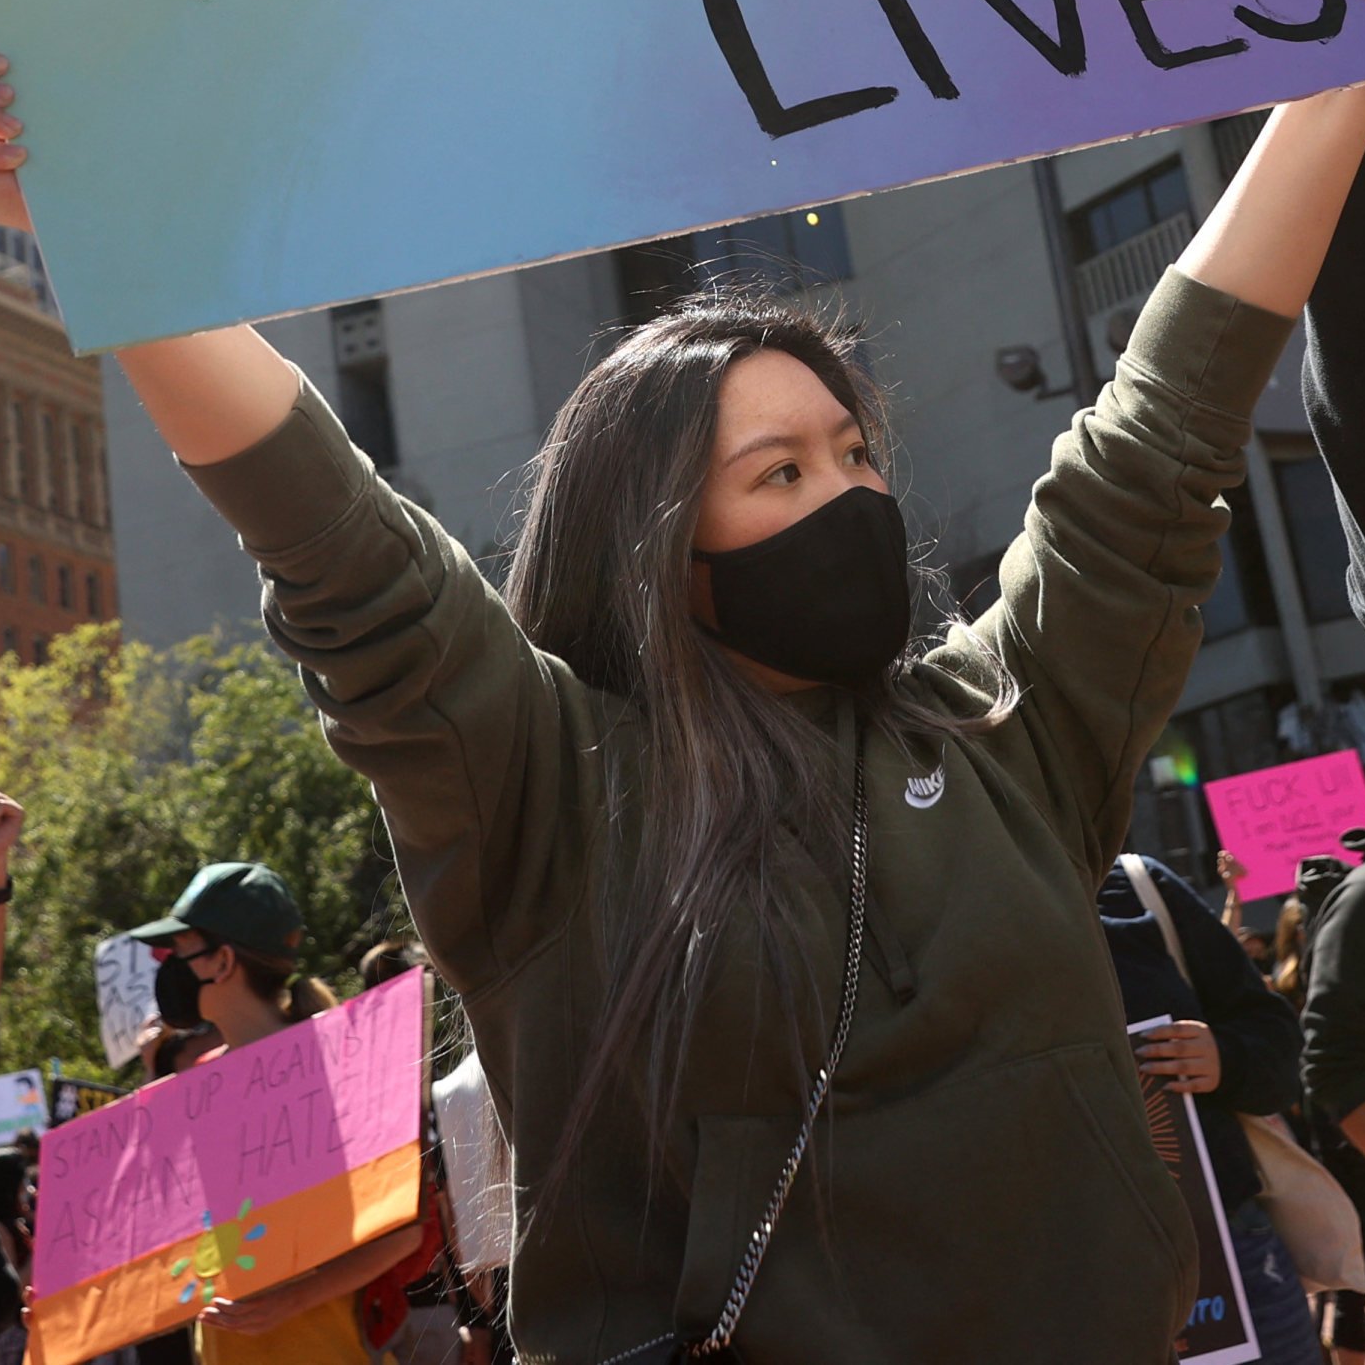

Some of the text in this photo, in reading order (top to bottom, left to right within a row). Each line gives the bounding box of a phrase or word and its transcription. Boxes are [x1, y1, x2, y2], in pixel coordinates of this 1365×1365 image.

[907, 763, 944, 795] NIKE
[1224, 772, 1308, 818] FUCK
[98, 936, 141, 986] ST
[105, 971, 148, 1014] AS
[109, 1005, 147, 1053] HA
[52, 1105, 154, 1179] STAND
[184, 1071, 224, 1121] UP
[46, 1145, 197, 1257] ASIAN
